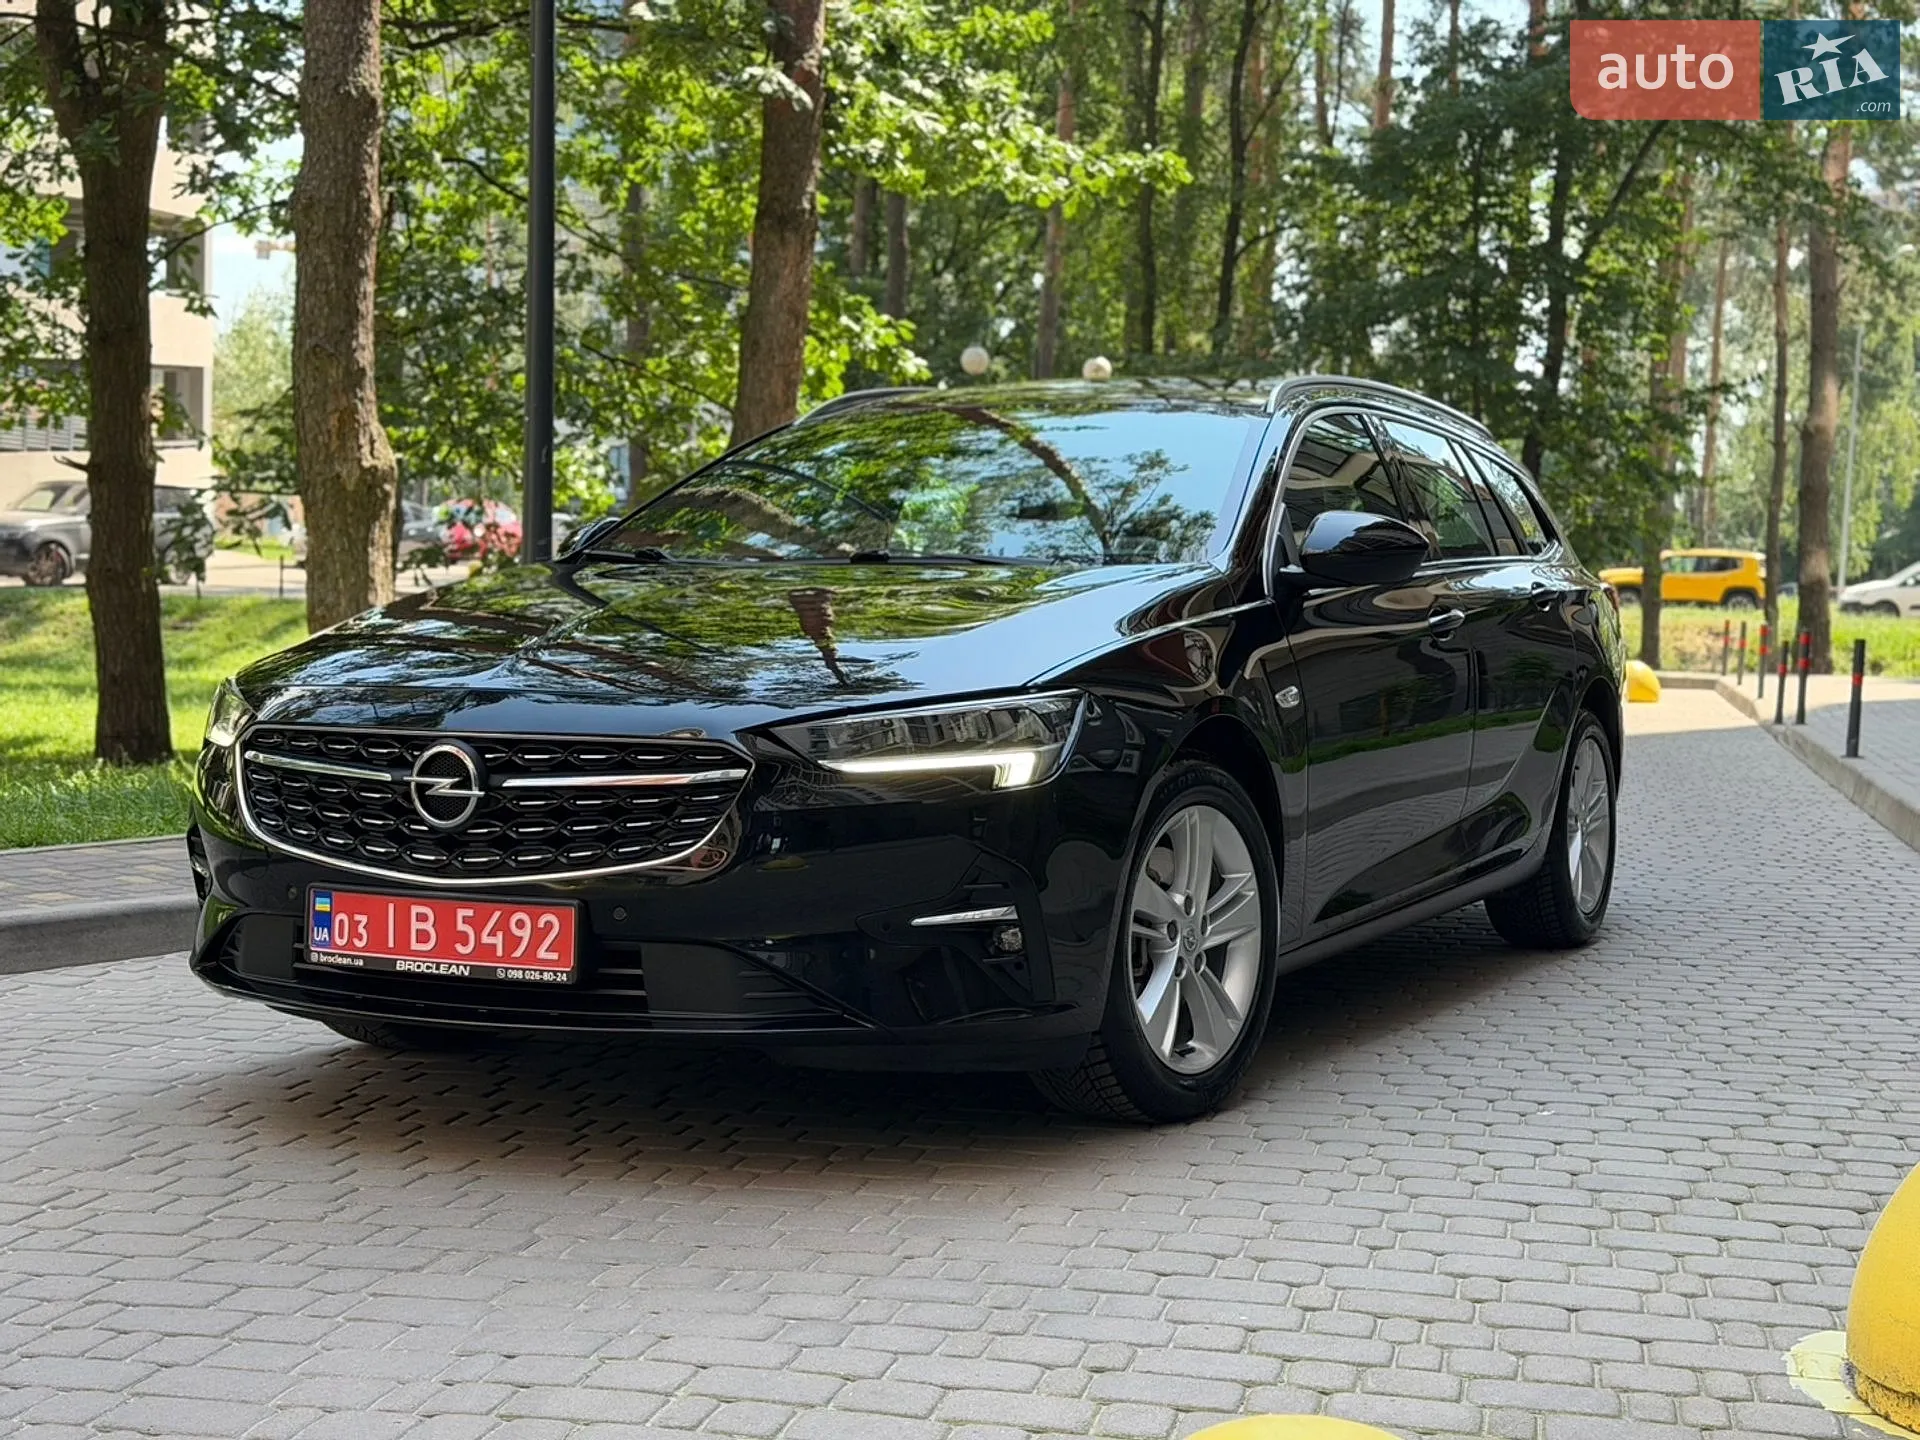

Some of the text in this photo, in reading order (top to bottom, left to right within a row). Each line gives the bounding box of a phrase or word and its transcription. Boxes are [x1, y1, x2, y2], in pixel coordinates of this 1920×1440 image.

[313, 926, 330, 942] UA
[333, 911, 368, 948] 03
[453, 907, 560, 960] 5492
[319, 953, 364, 967] broclean.ua
[395, 959, 471, 977] BROCLEAN
[506, 968, 524, 980] 098
